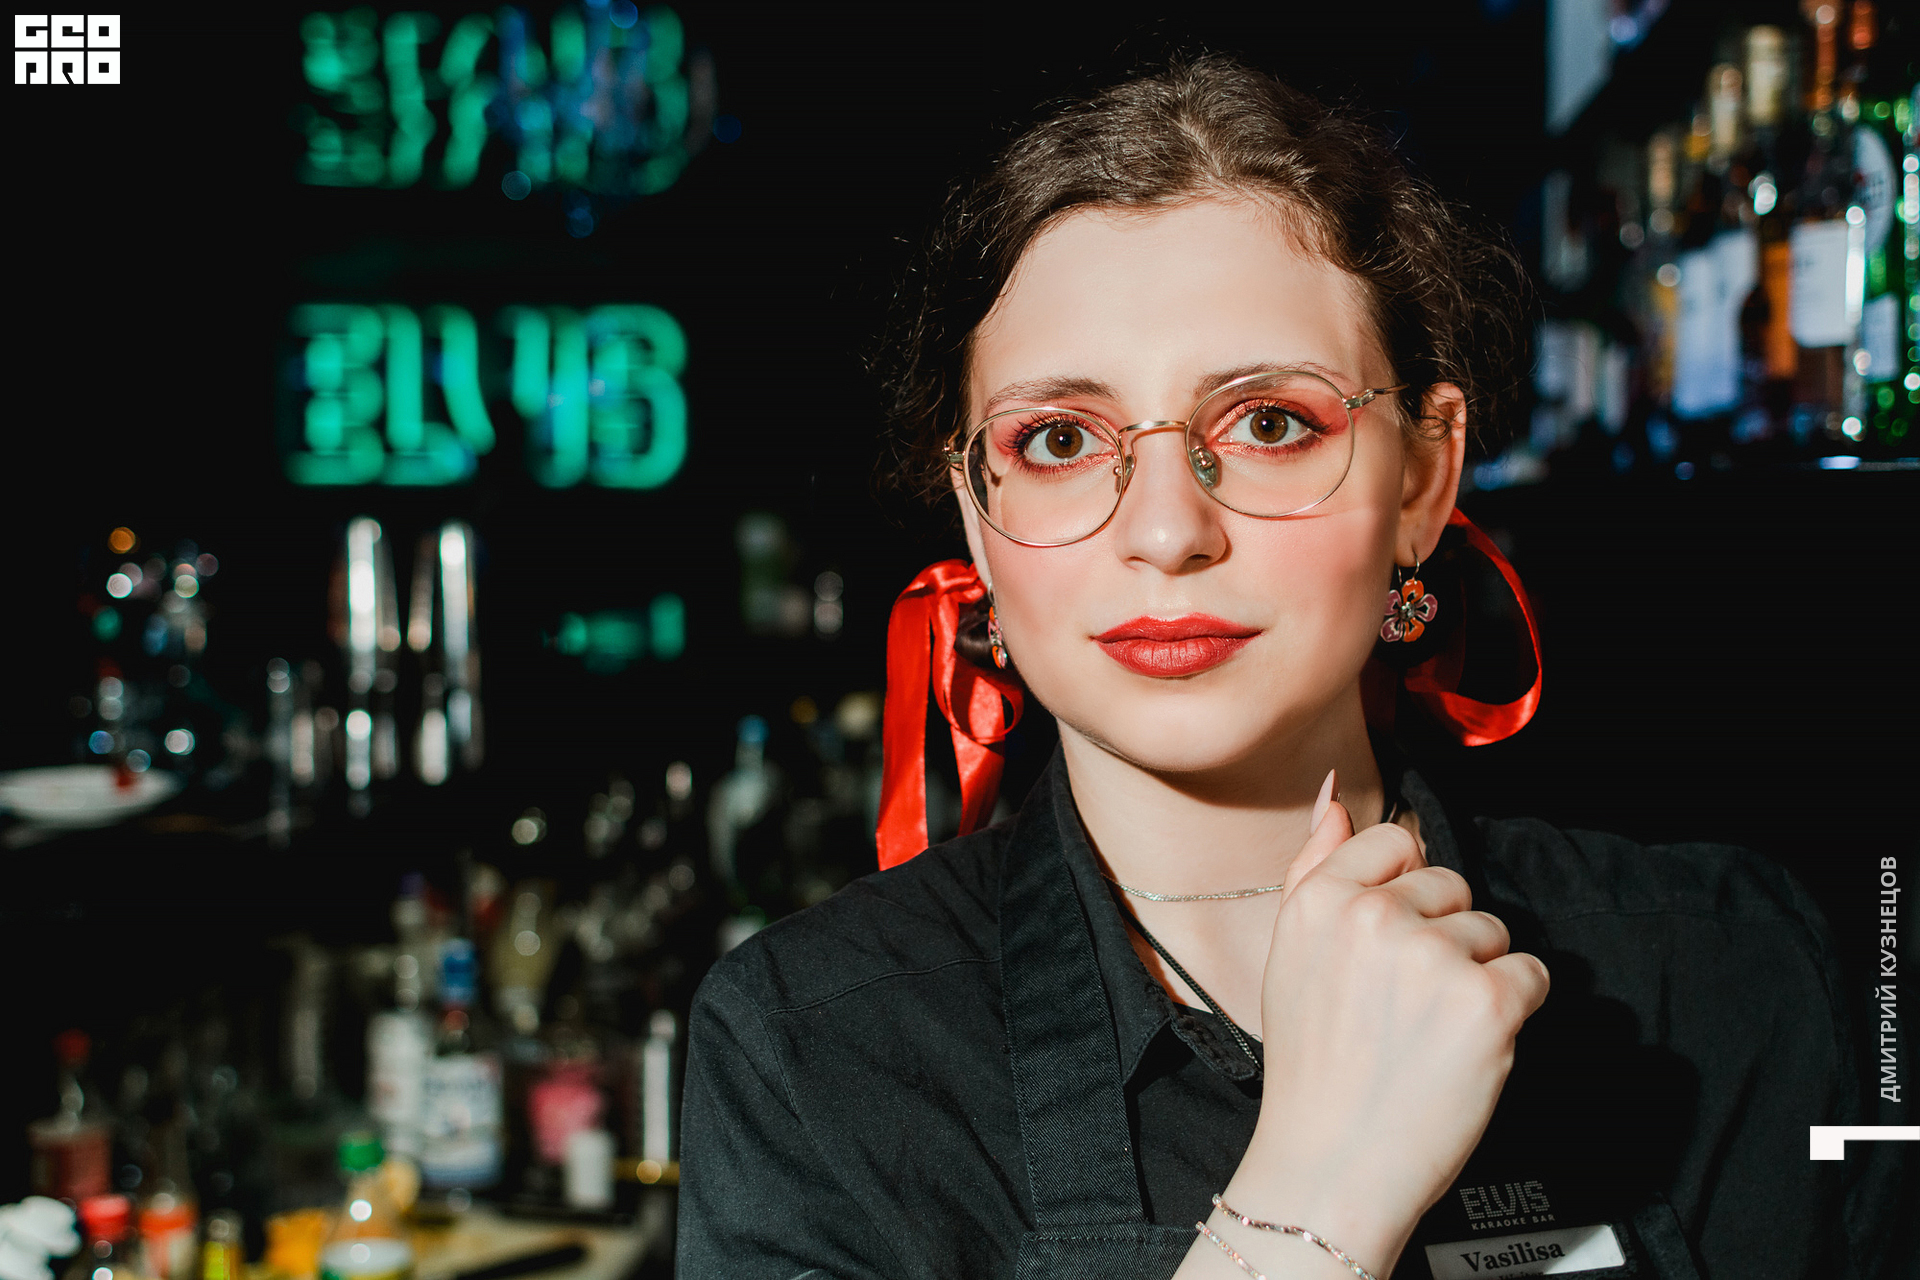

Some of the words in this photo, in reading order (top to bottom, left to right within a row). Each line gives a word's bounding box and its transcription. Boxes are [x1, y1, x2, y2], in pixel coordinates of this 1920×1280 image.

[1459, 1180, 1550, 1220] ELVIS
[1471, 1217, 1527, 1231] KARAOKE
[1532, 1214, 1556, 1224] BAR
[1460, 1241, 1566, 1273] Vasilisa
